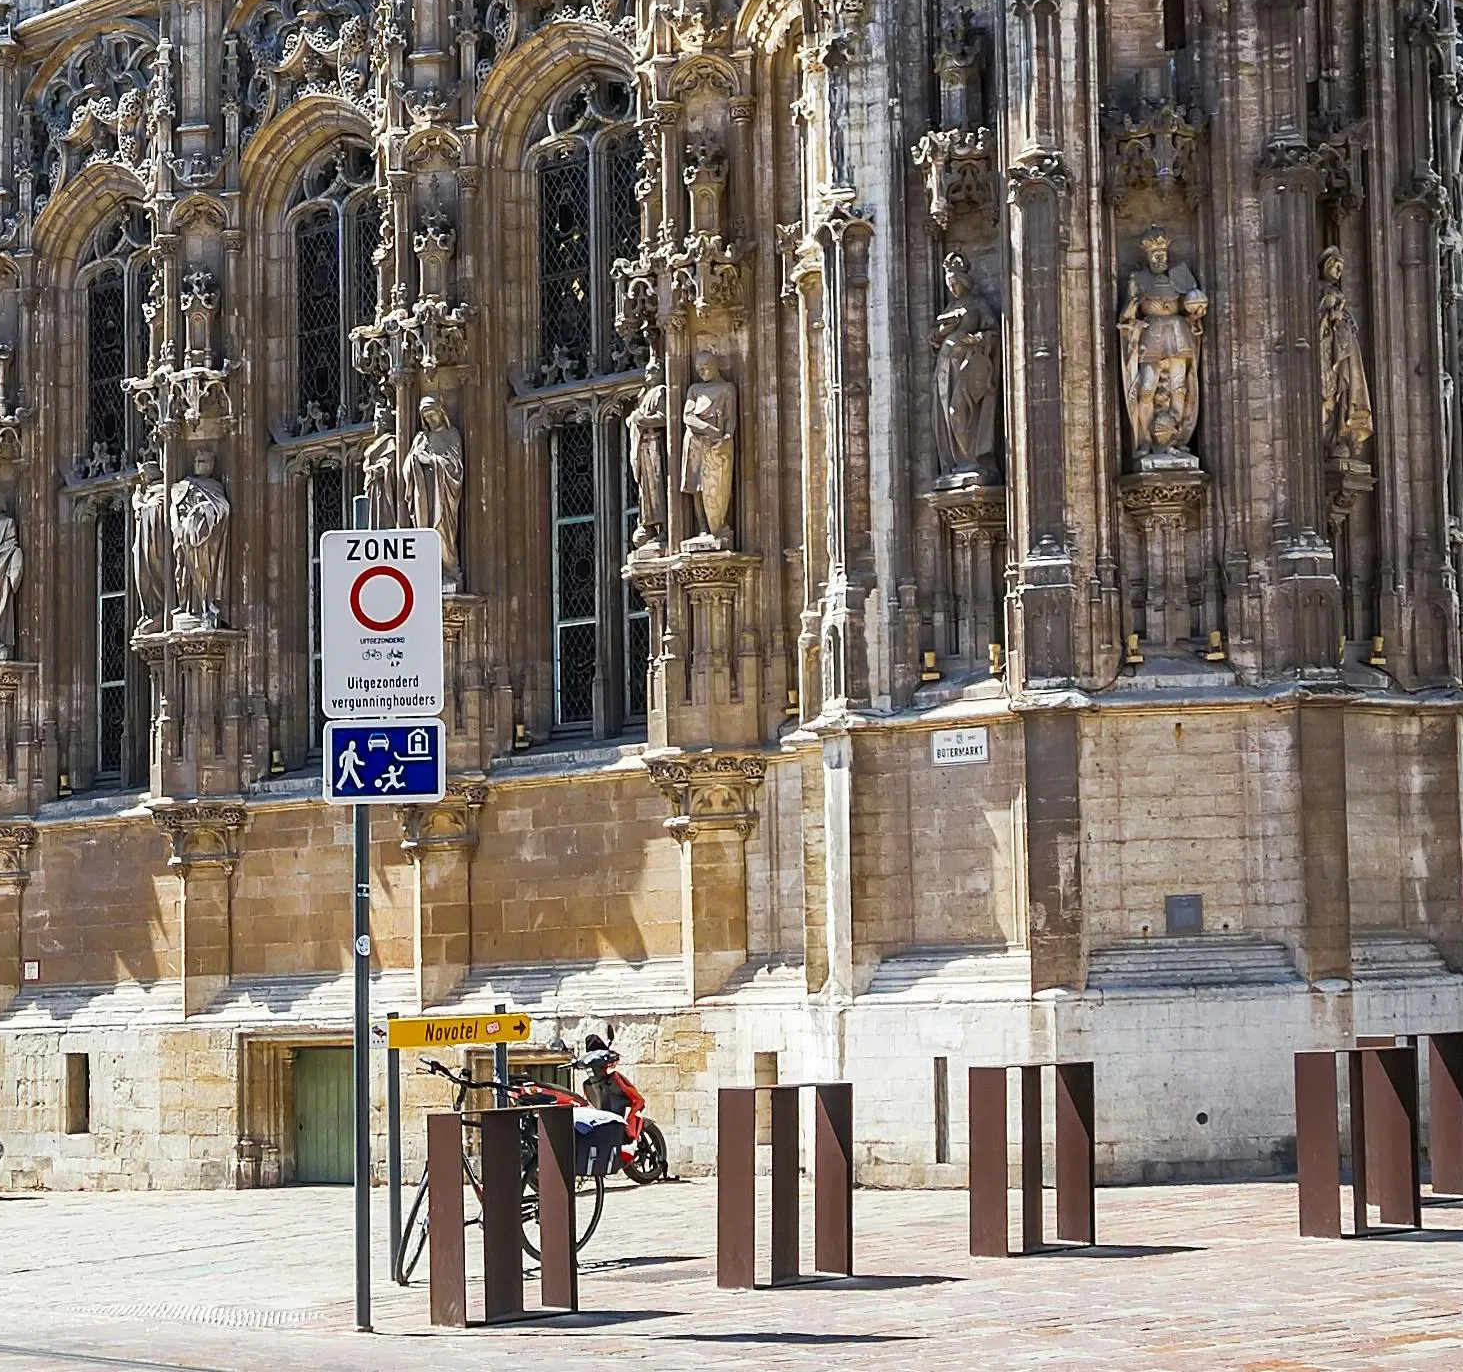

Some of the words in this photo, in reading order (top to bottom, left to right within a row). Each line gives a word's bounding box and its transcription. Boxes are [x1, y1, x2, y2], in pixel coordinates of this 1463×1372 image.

[346, 538, 416, 561] ZONE
[347, 675, 419, 692] Uitgezonderd
[331, 694, 436, 712] vergunninghouders
[936, 745, 984, 759] BOTERMARKT
[425, 1021, 479, 1042] Novotel
